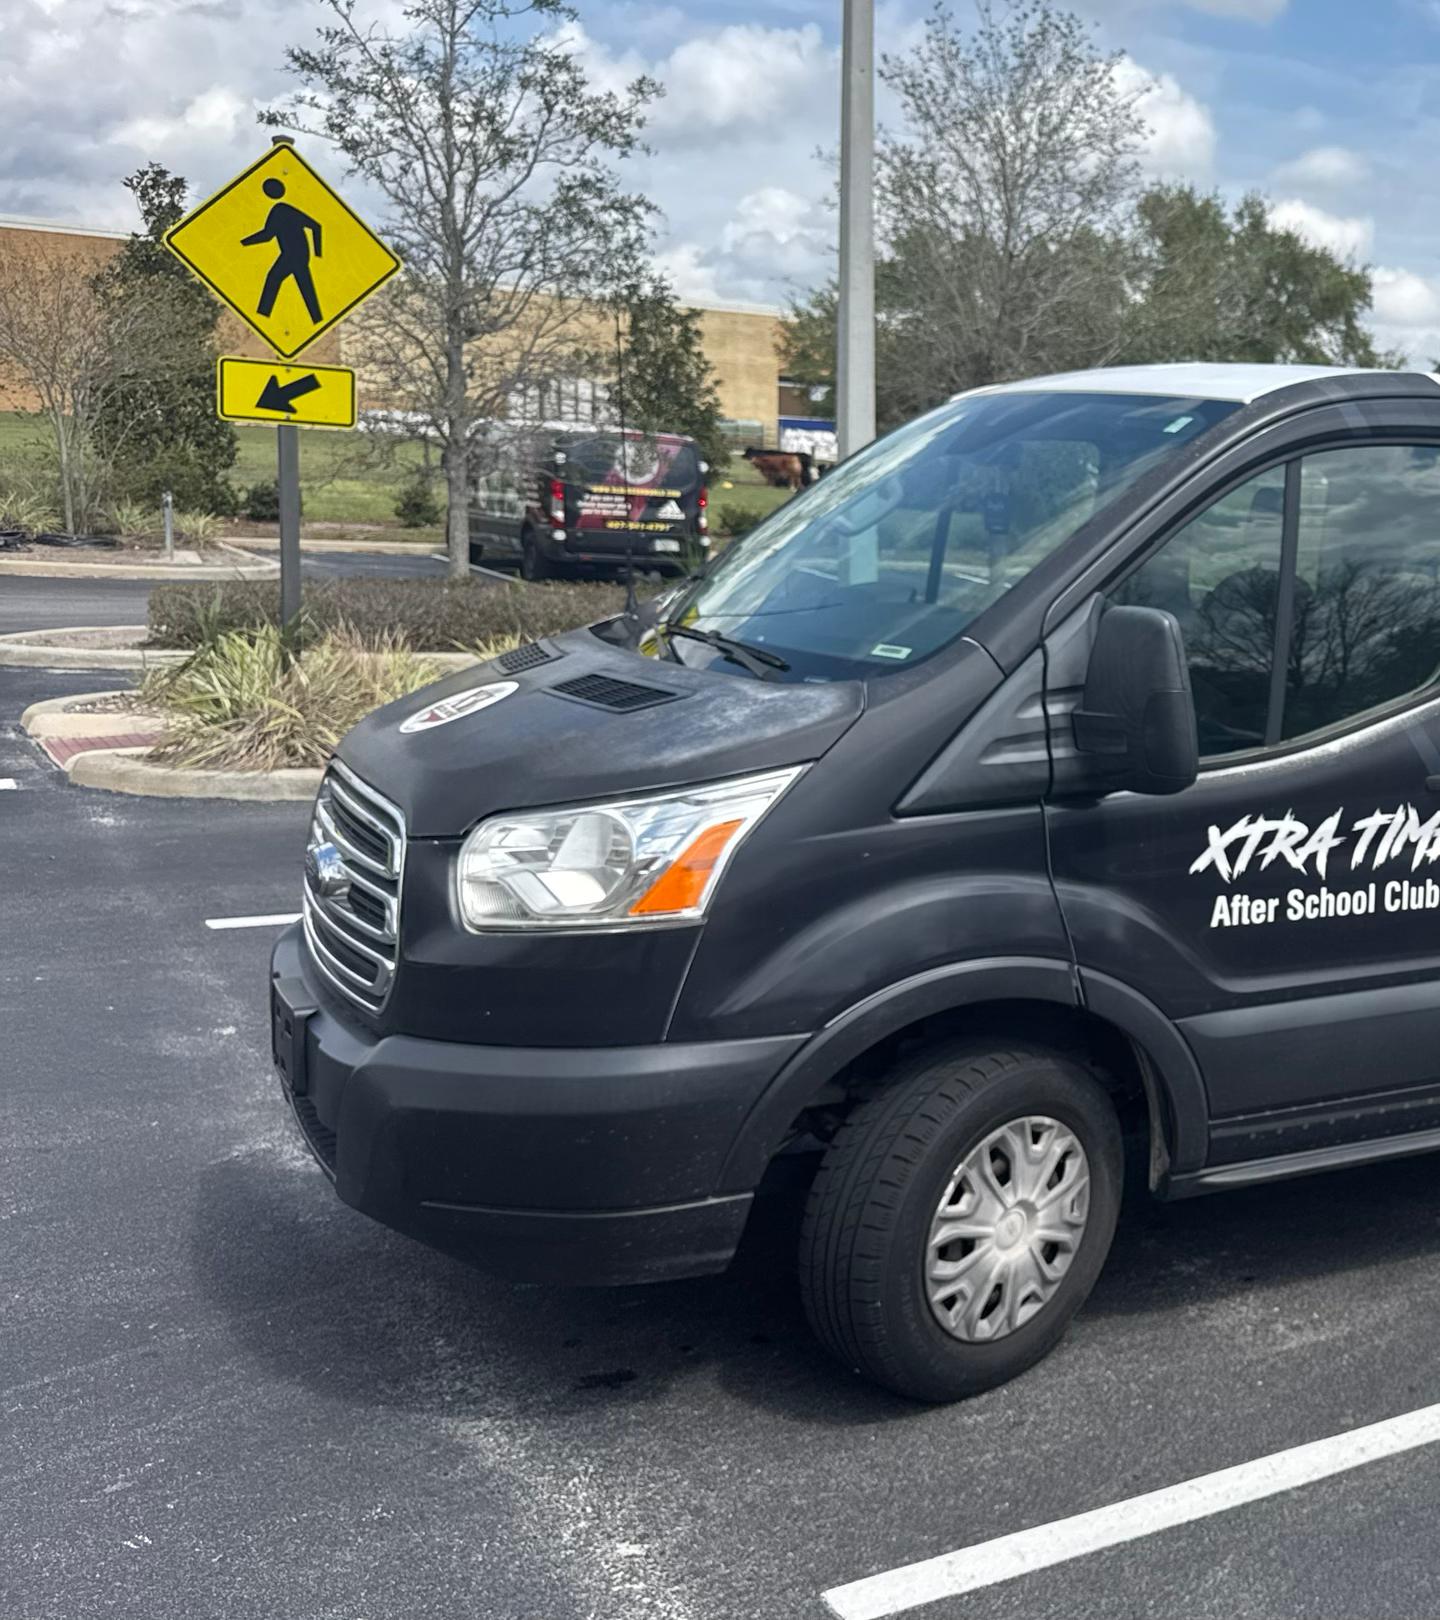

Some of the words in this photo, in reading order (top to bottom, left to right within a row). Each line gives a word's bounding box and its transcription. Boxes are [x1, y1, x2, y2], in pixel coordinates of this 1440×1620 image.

[1188, 806, 1348, 885] XTRA
[1209, 895, 1280, 928] After
[1286, 883, 1376, 922] School
[1383, 878, 1440, 913] Club
